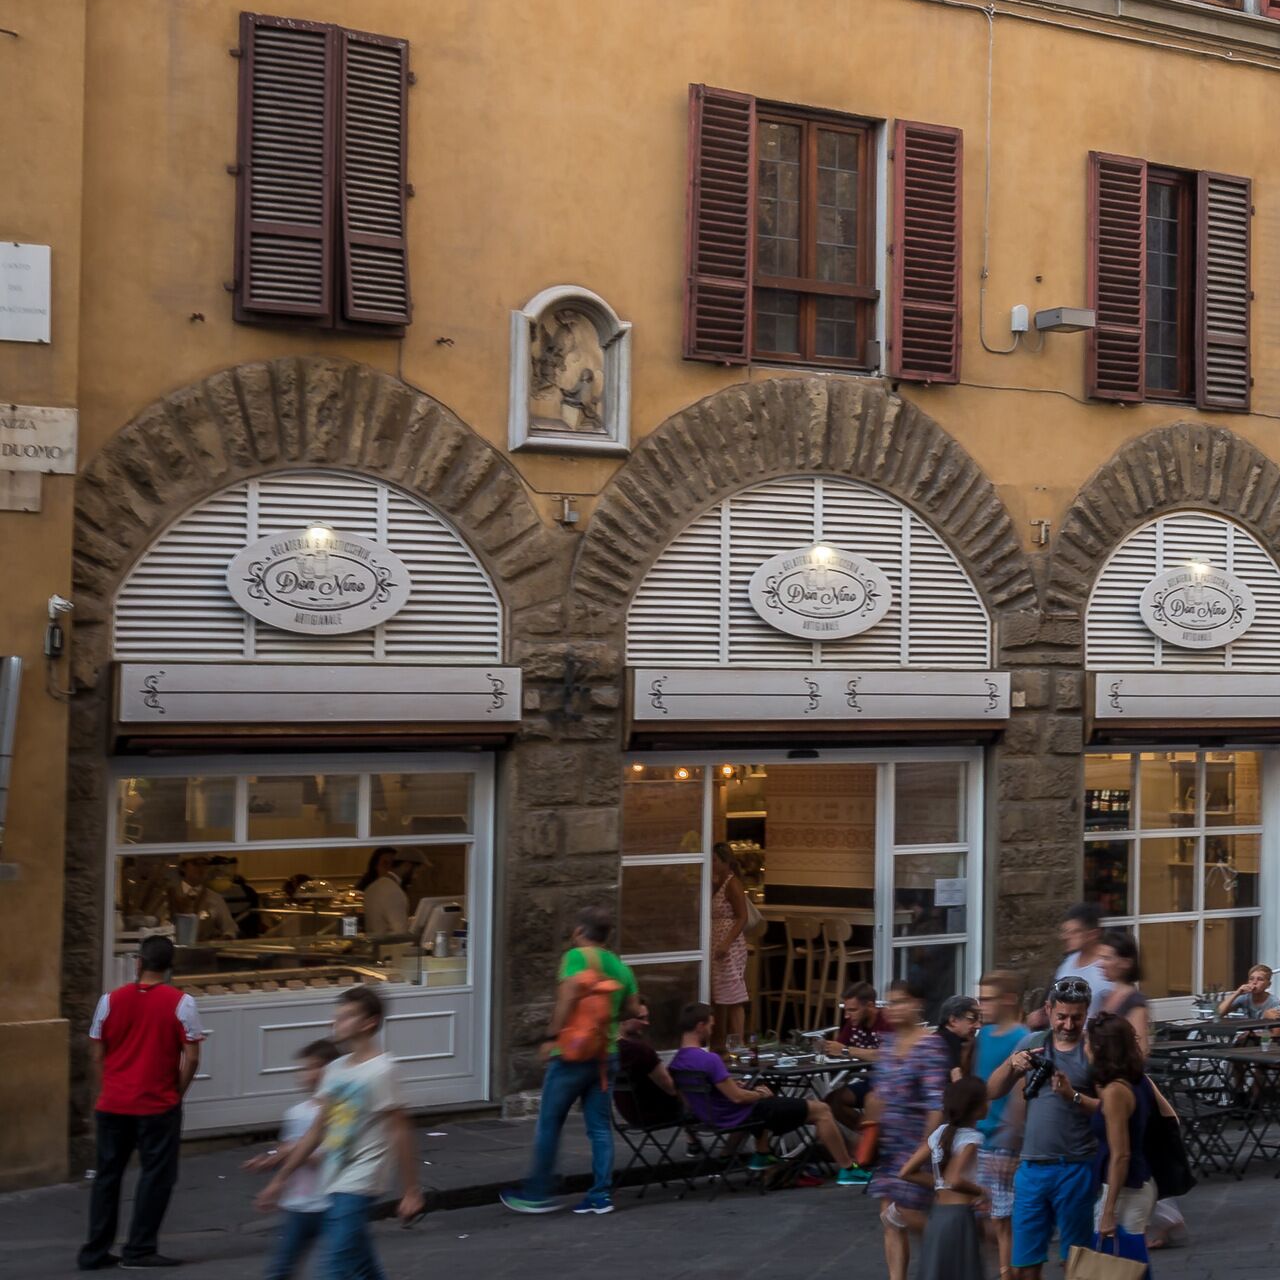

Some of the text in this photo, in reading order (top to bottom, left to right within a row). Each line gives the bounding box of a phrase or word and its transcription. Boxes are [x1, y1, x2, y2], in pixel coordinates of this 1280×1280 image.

[2, 443, 64, 460] DUOMO
[276, 570, 366, 596] Don Nino
[787, 583, 857, 605] Don Nino
[1170, 598, 1227, 618] Don Nino
